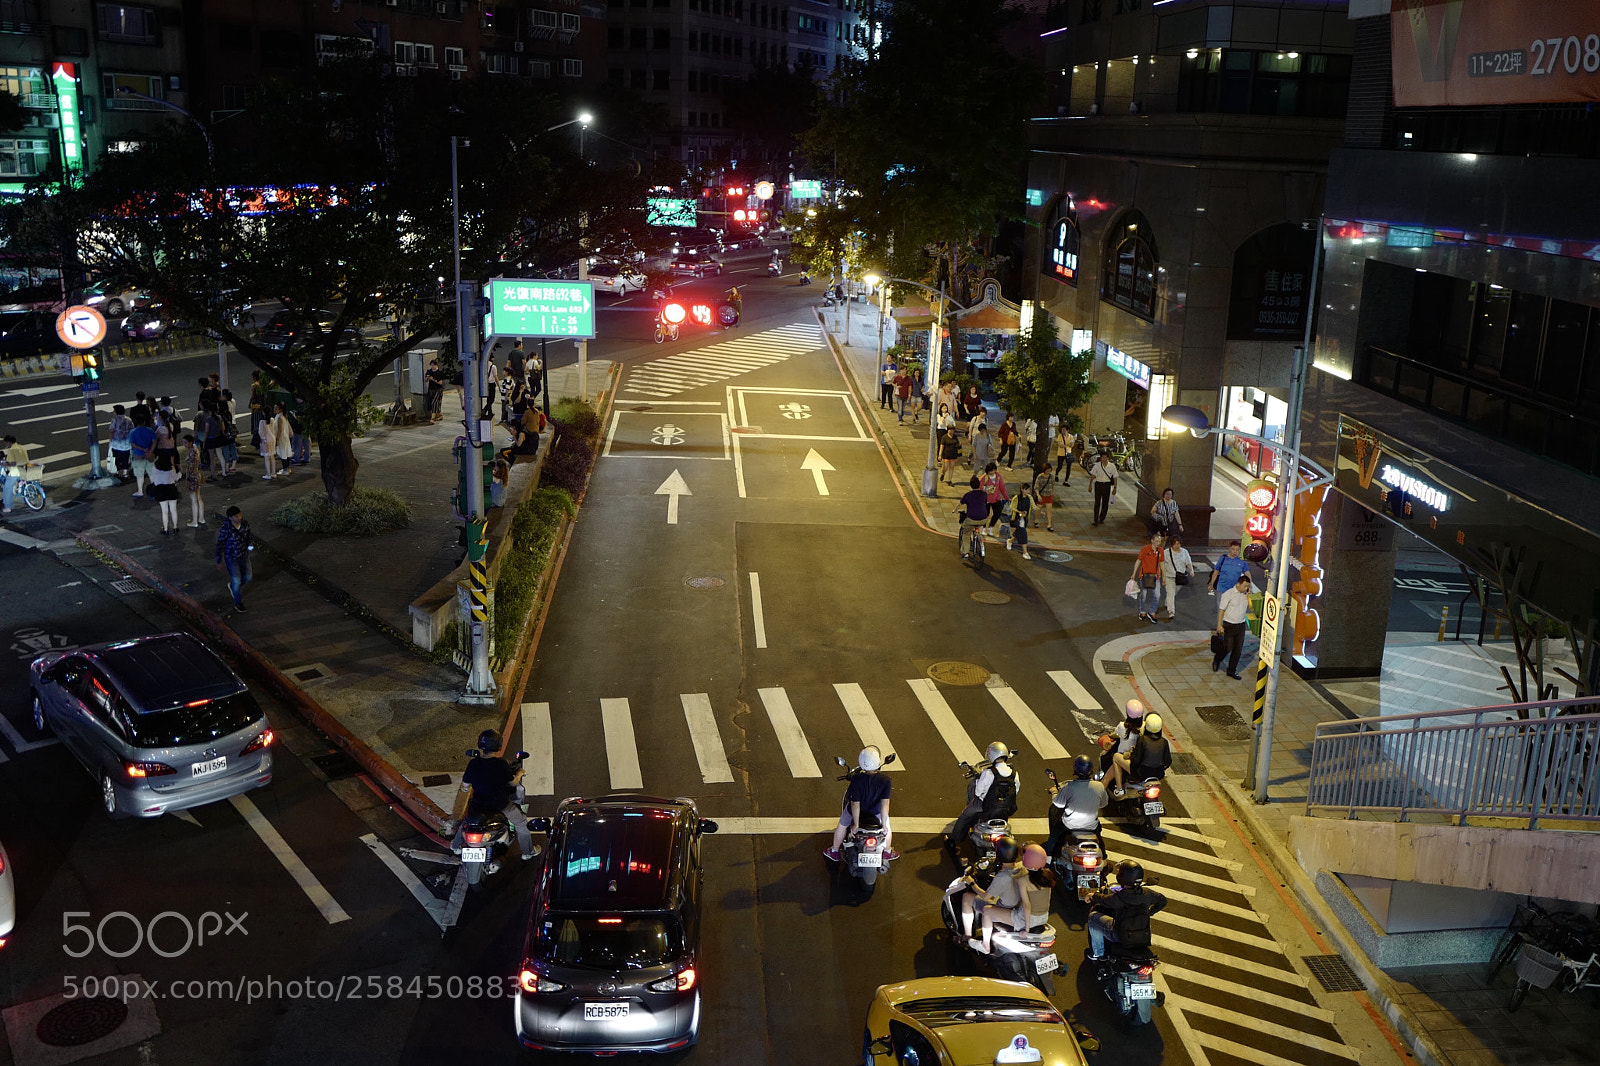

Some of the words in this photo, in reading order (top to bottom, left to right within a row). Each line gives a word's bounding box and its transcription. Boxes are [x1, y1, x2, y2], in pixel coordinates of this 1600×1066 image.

[1472, 52, 1522, 74] 11~22坪
[1530, 34, 1600, 75] 2708
[503, 287, 582, 301] 光復南路692巷
[552, 305, 567, 313] Lane
[569, 306, 582, 314] 692
[1355, 530, 1378, 543] 688
